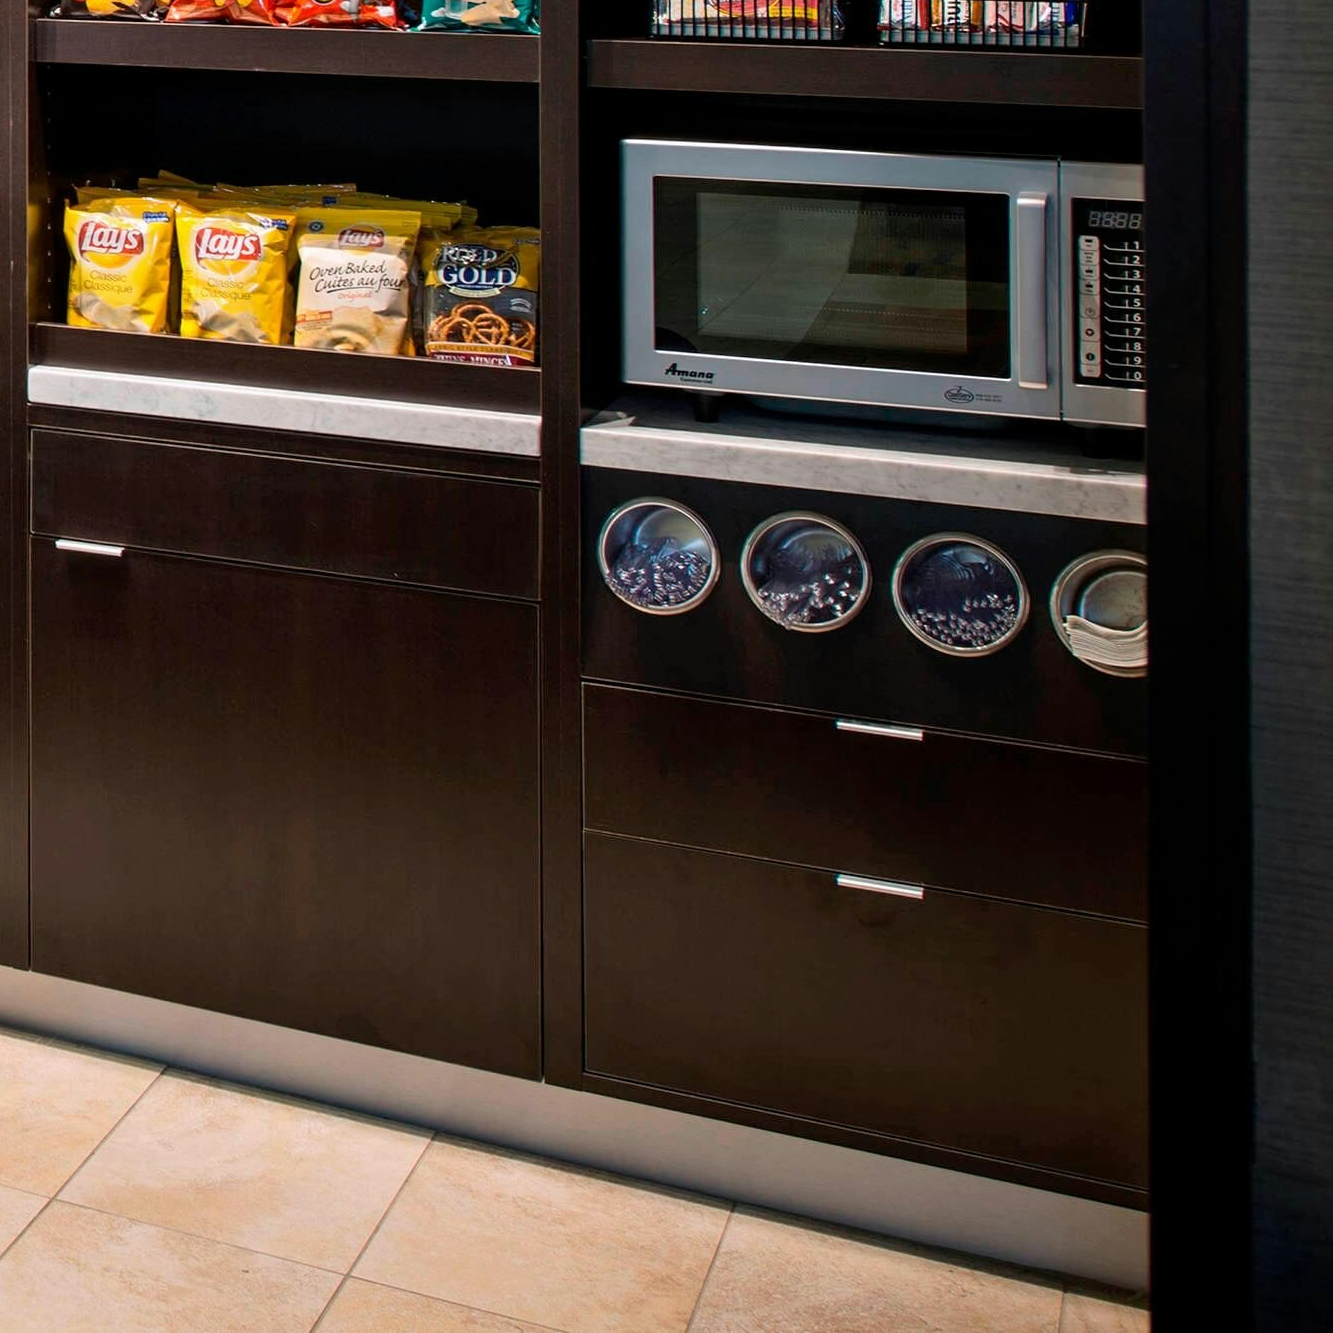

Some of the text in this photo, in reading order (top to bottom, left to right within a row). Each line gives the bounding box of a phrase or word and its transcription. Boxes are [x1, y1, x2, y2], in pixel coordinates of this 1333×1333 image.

[80, 220, 140, 254] Lay's
[198, 227, 259, 260] Lay's
[1133, 241, 1141, 250] 1
[1133, 255, 1141, 265] 2
[309, 260, 386, 281] Oven Baked
[1133, 270, 1141, 279] 3
[90, 270, 127, 282] Classic
[438, 266, 517, 286] GOLD
[83, 280, 133, 292] Classique
[206, 277, 243, 289] Classic
[314, 273, 405, 293] Cuites au four
[1133, 284, 1141, 294] 4
[1133, 298, 1141, 307] 5
[1133, 313, 1141, 322] 6
[1133, 327, 1141, 336] 7
[1133, 342, 1141, 351] 8
[1133, 356, 1141, 365] 9
[664, 362, 714, 378] Amana
[1133, 371, 1141, 380] 0
